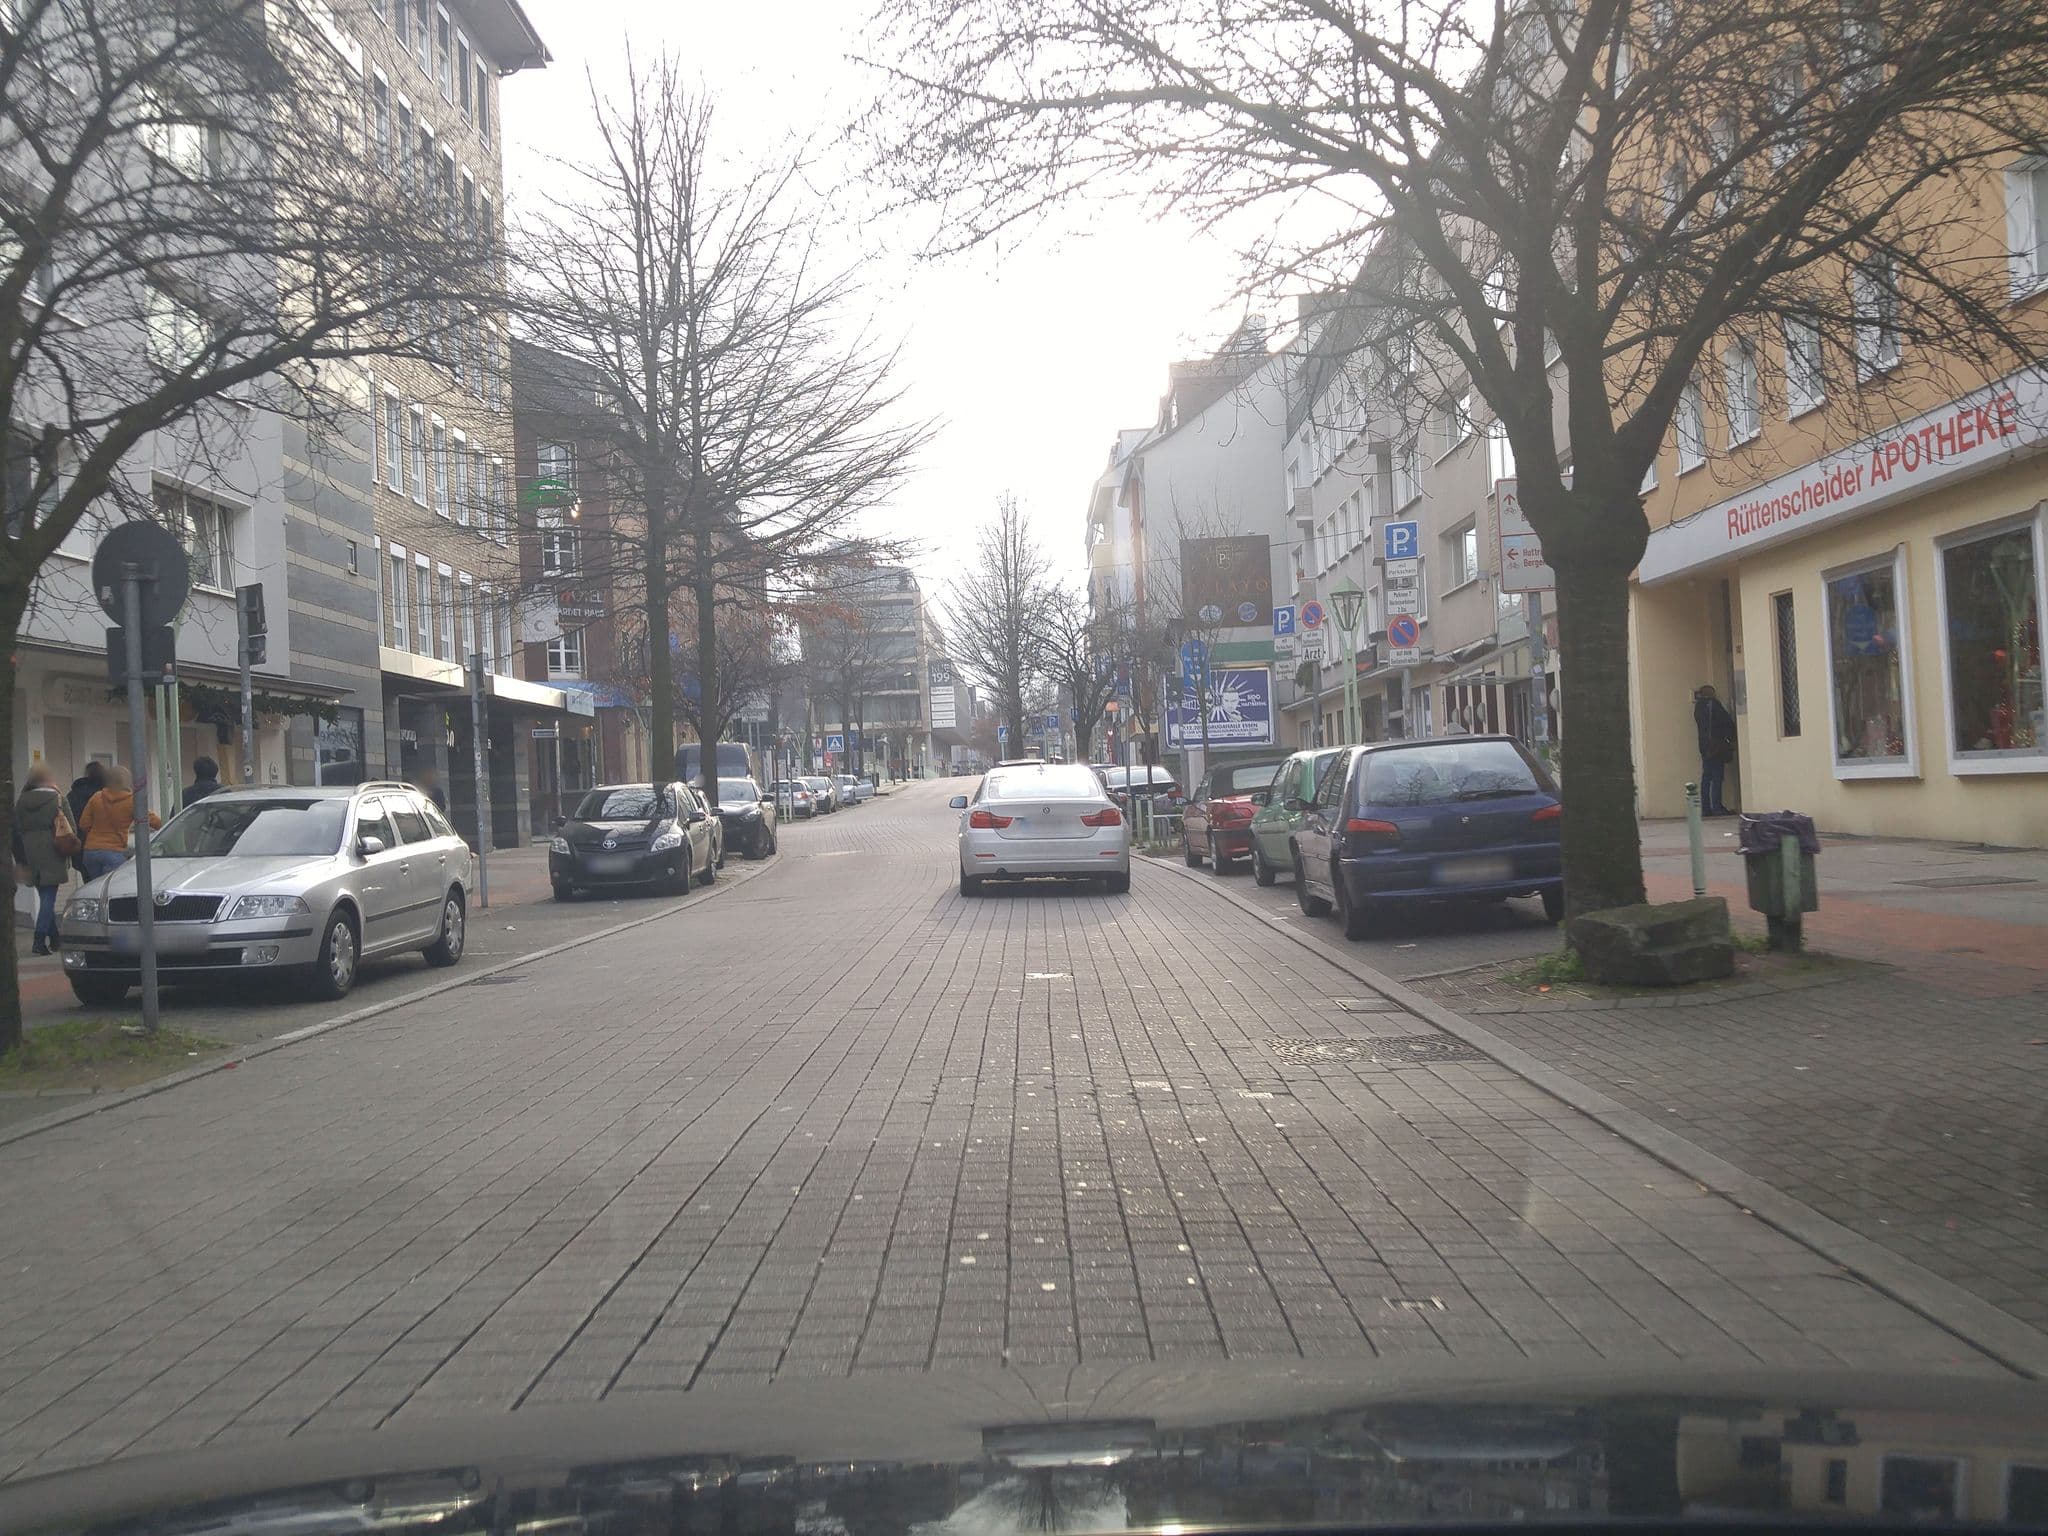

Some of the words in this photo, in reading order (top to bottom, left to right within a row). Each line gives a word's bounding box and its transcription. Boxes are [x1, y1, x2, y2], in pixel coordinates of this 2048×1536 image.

[1727, 464, 1864, 540] Rüttenscheider
[1870, 391, 2017, 487] APOTHEKE
[1392, 528, 1410, 554] P
[1278, 610, 1290, 632] P
[1304, 648, 1321, 660] Arzt
[931, 672, 950, 682] 199
